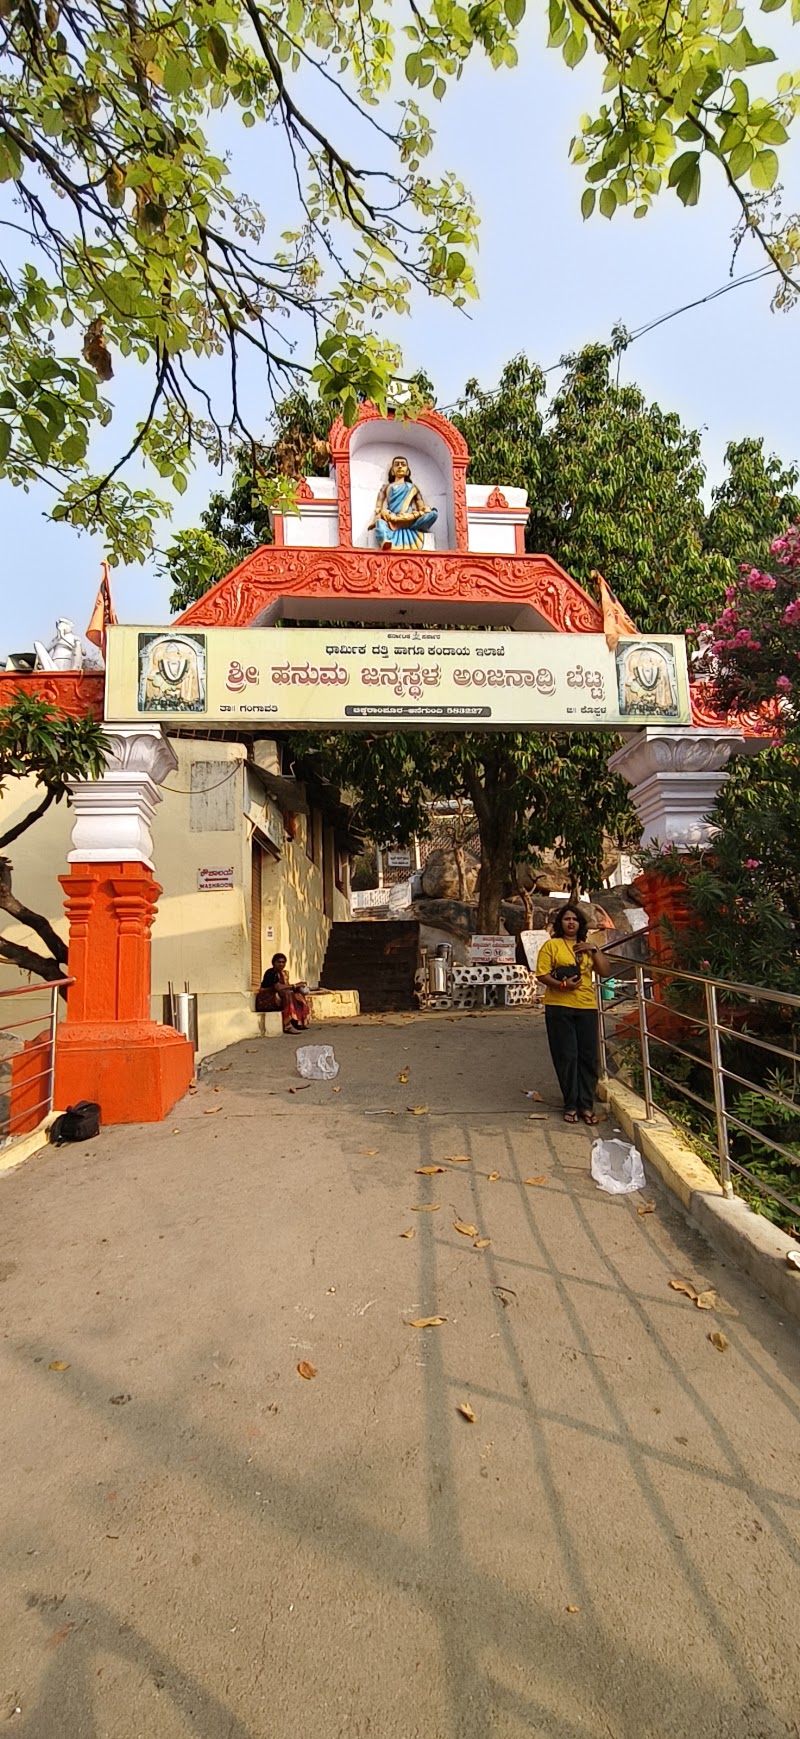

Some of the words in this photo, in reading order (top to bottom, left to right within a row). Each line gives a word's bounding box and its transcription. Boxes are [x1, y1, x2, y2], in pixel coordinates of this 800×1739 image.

[325, 644, 367, 655] ಧಾರ್ಮಿಕ
[371, 644, 390, 658] ದತ್ತಿ
[393, 645, 425, 656] ಹಾಗೂ
[427, 646, 471, 656] ಕಂದಾಯ
[225, 660, 259, 693] ಶ್ರೀ
[271, 660, 349, 686] ಹನುಮ
[361, 662, 441, 700] ಜನ್ಮಸ್ಥಳ
[453, 666, 556, 696] ಅಂಜನಾದ್ರಿ
[566, 664, 606, 701] ಬೆಟ್ಟ
[239, 704, 278, 712] ಗಂಗಾವತಿ
